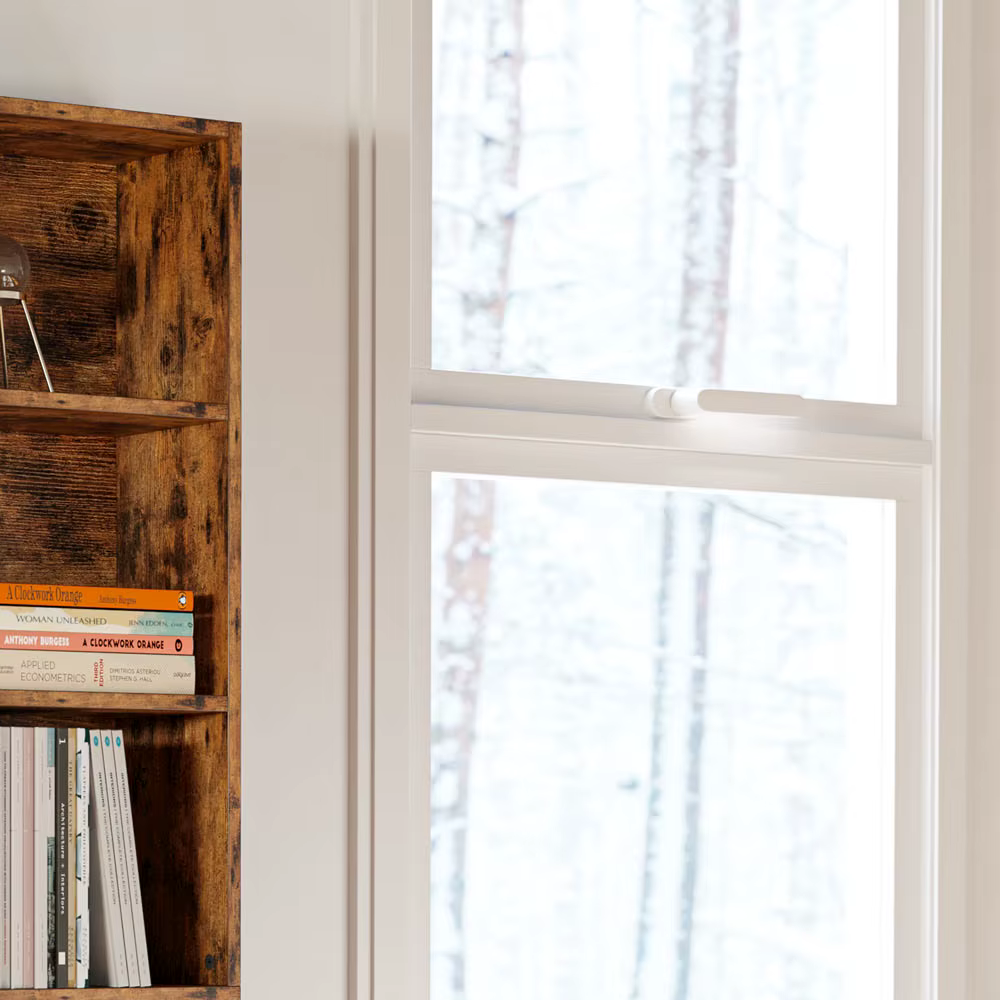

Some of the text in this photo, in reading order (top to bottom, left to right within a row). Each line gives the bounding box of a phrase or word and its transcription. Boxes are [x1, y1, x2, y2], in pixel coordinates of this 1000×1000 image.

[6, 584, 83, 605] A Clockwork Orange
[15, 614, 107, 625] WOMAN UNLEASHED
[4, 635, 70, 647] ANTHONY BURGESS
[82, 638, 164, 650] A CLOCKWORK ORANGE
[20, 660, 56, 670] APPLIED
[20, 672, 86, 684] ECONOMETRICS
